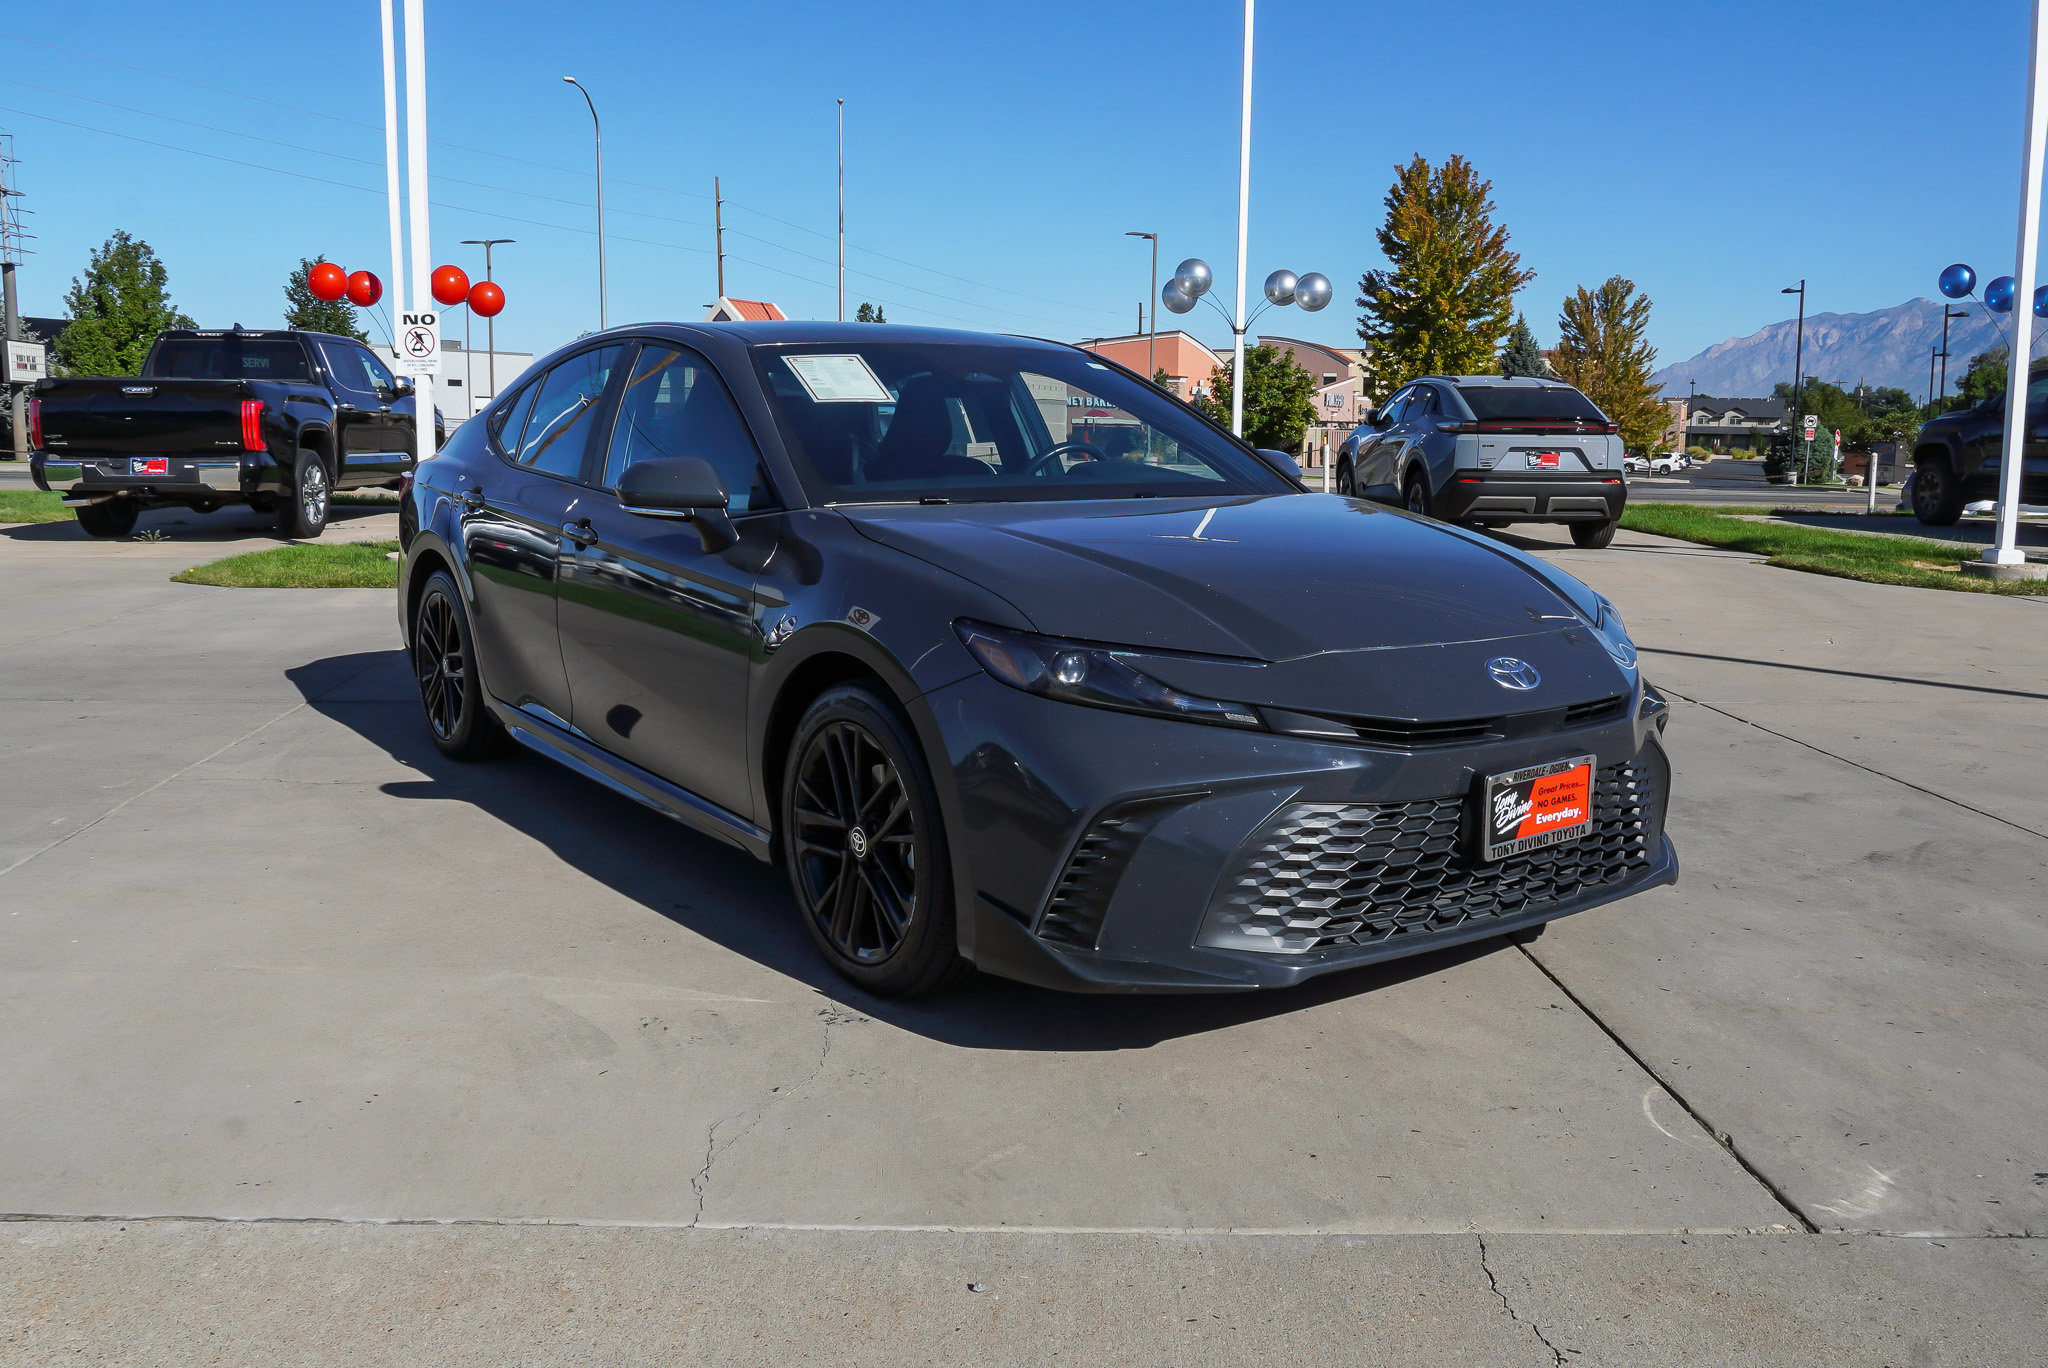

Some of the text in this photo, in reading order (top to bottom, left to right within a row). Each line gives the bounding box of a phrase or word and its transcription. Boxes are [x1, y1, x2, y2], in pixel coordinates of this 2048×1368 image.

[403, 314, 435, 325] NO
[1538, 785, 1557, 795] Great
[1494, 788, 1518, 813] Tony
[1537, 793, 1577, 808] NO GAMES.
[1493, 800, 1533, 828] Divino
[1536, 807, 1582, 824] Everyday.
[1491, 825, 1586, 858] TONY DIVINO TOYOTA
